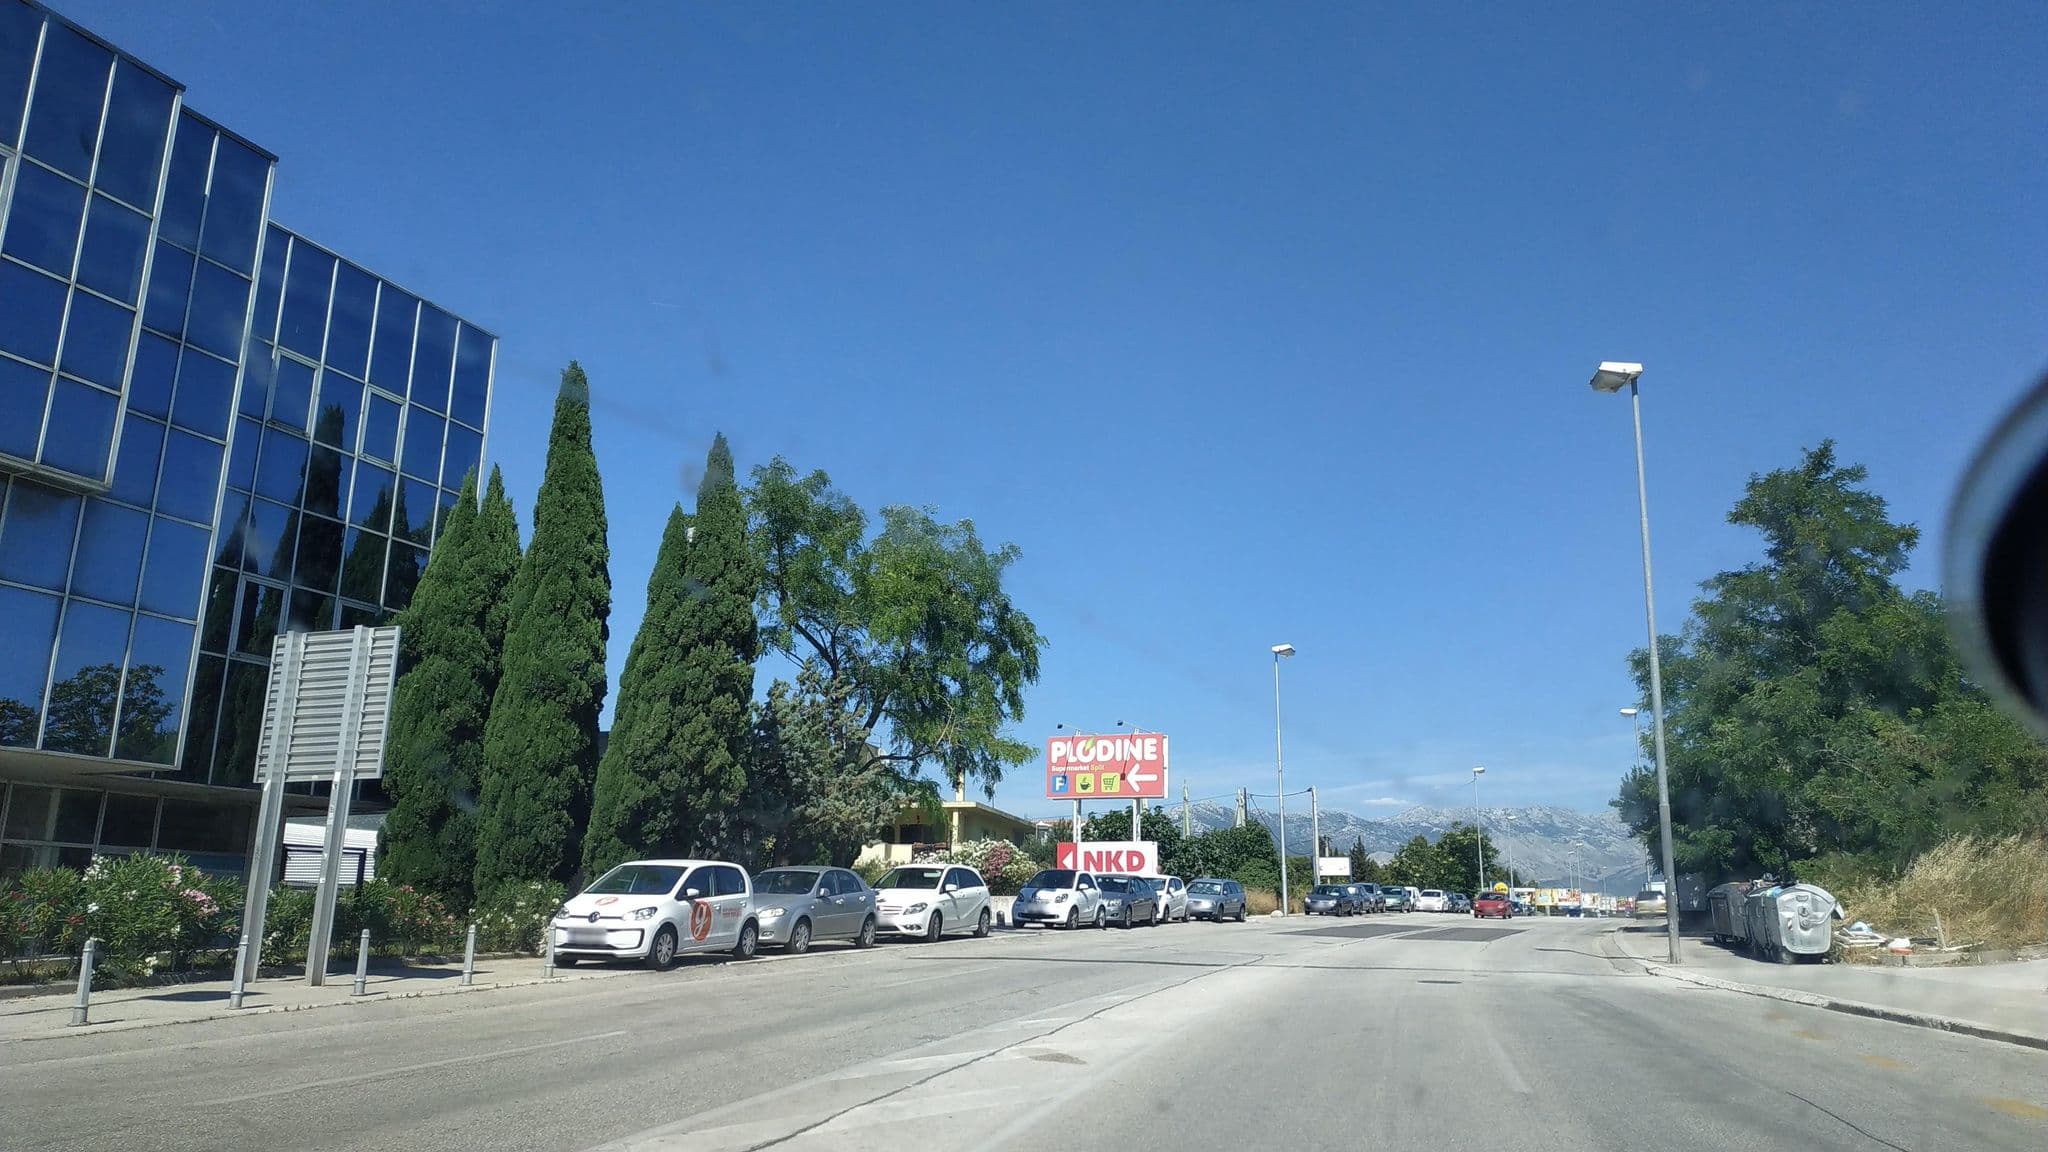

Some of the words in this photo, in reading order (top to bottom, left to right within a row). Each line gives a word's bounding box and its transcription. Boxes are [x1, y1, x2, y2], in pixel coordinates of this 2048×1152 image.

[1051, 738, 1158, 763] PLODINE
[1051, 764, 1090, 772] Supermarket
[1083, 850, 1146, 872] NKD
